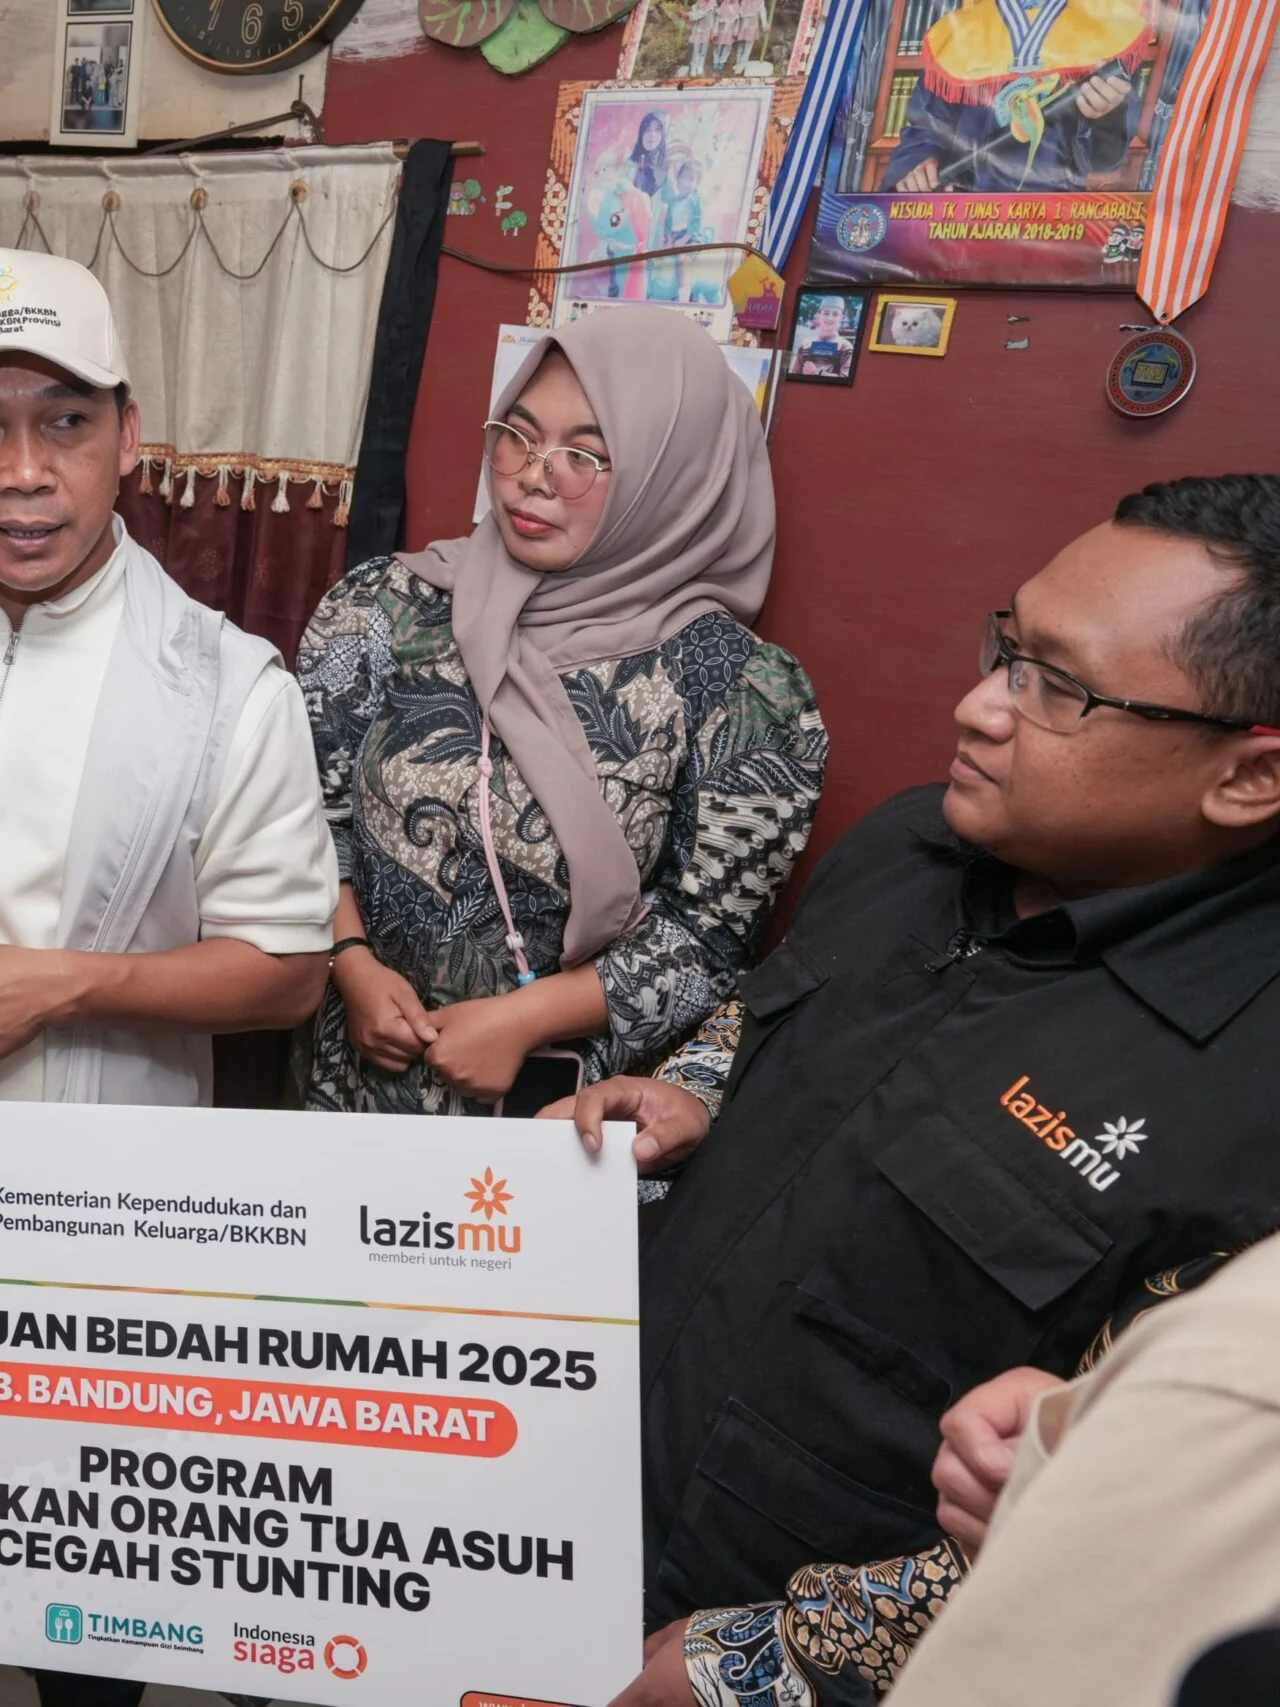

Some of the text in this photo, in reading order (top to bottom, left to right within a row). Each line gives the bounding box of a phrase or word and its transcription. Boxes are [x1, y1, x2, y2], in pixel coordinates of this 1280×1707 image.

[241, 3, 263, 45] 6
[890, 201, 1144, 219] WISUDA TK TUNAS KARYA 1 RANCABALI
[929, 222, 1085, 240] TAHUN AJARAN 2018-2019
[22, 316, 61, 327] Provinsi
[1000, 1075, 1121, 1192] lazismu
[117, 1193, 264, 1216] Kependudukan
[270, 1200, 307, 1219] dan
[134, 1220, 307, 1246] Keluarga/BKKBN
[360, 1205, 521, 1253] lazismu
[369, 1252, 512, 1271] memberi untuk negeri
[86, 1316, 249, 1364] BEDAH
[259, 1328, 447, 1379] RUMAH
[458, 1343, 597, 1391] 2025
[28, 1374, 223, 1425] BANDUNG,
[229, 1391, 348, 1430] JAWA
[355, 1401, 495, 1442] BARAT
[80, 1446, 333, 1507] PROGRAM
[110, 1495, 289, 1549] ORANG
[300, 1512, 410, 1562] TUA
[422, 1526, 574, 1581] ASUH
[170, 1547, 431, 1613] STUNTING
[87, 1613, 204, 1645] TIMBANG
[87, 1634, 121, 1643] Tingkatkan
[233, 1622, 315, 1646] Indonesia
[233, 1641, 315, 1674] siaga
